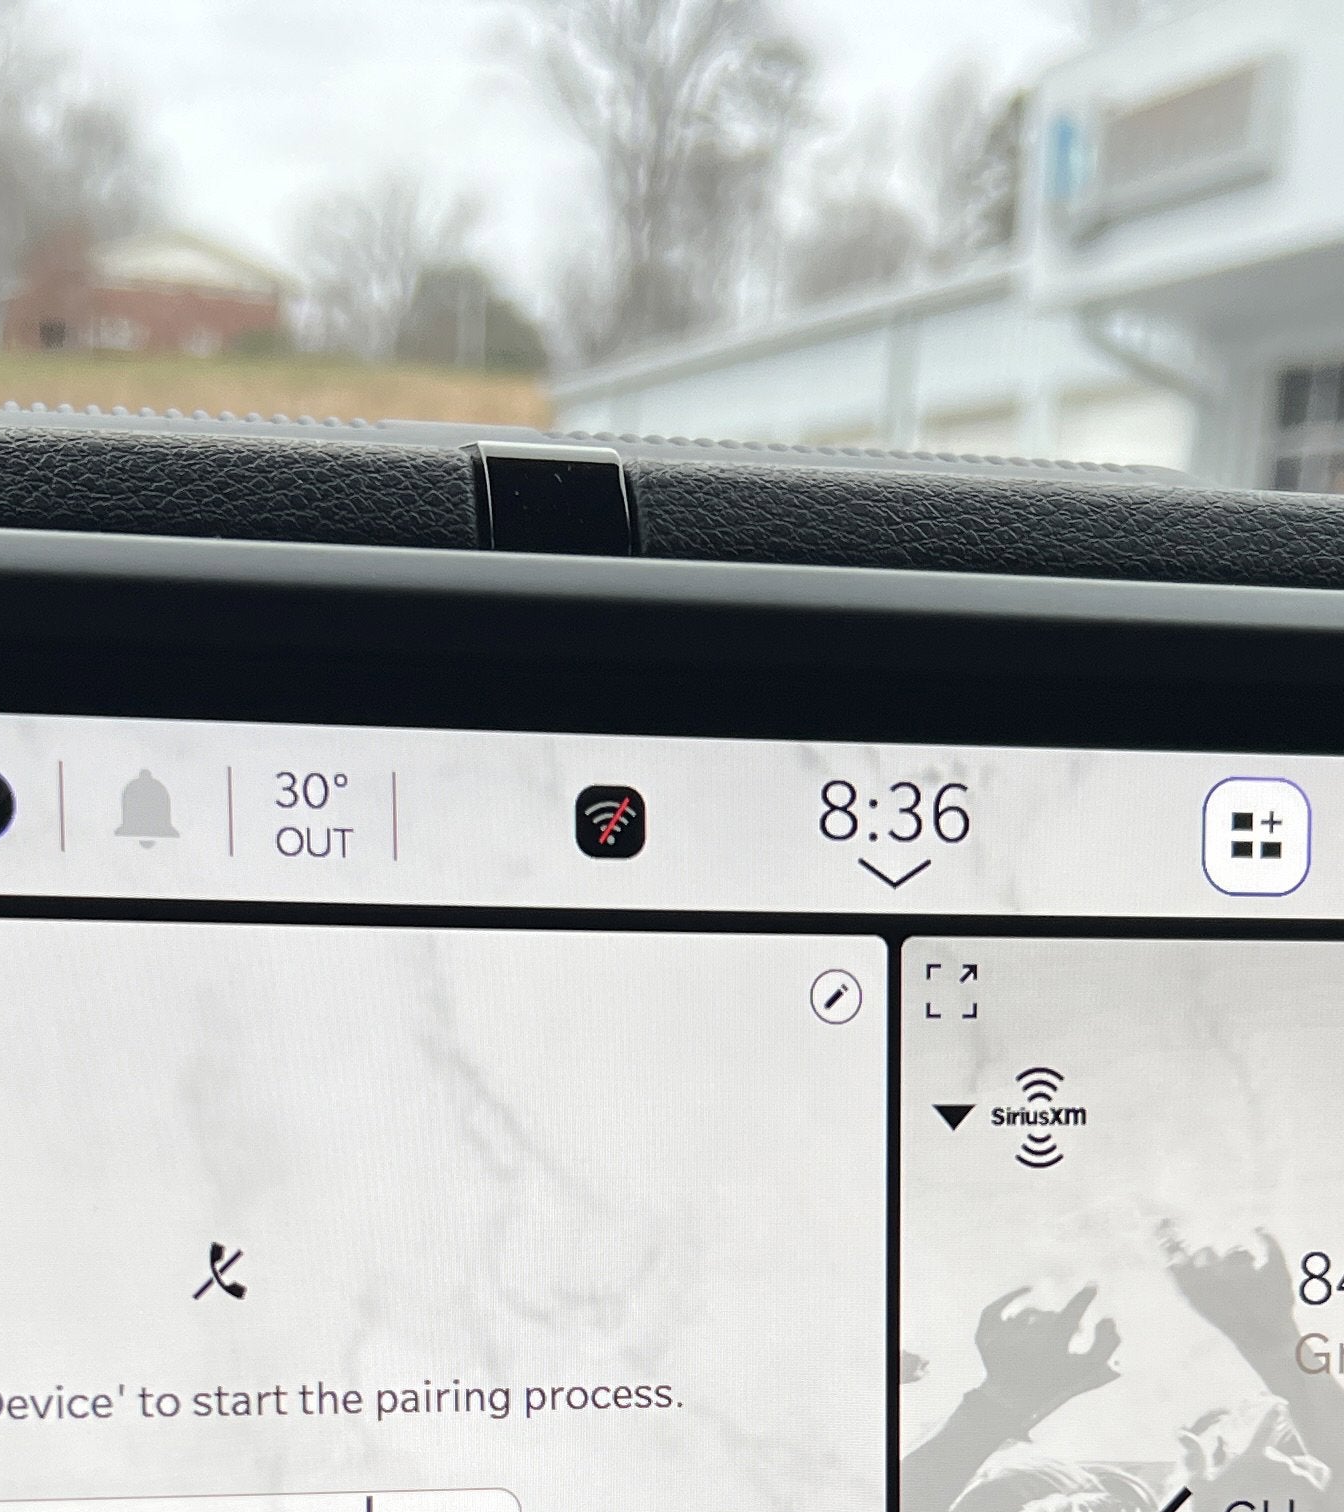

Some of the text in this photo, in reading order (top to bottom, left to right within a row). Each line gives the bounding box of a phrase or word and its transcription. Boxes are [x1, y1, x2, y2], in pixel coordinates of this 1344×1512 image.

[275, 771, 348, 809] 30°
[819, 780, 970, 843] 8:36
[275, 827, 354, 859] OUT
[138, 1386, 181, 1418] to
[192, 1385, 289, 1417] start
[299, 1381, 363, 1415] the
[376, 1378, 511, 1421] pairing
[525, 1383, 684, 1419] process.
